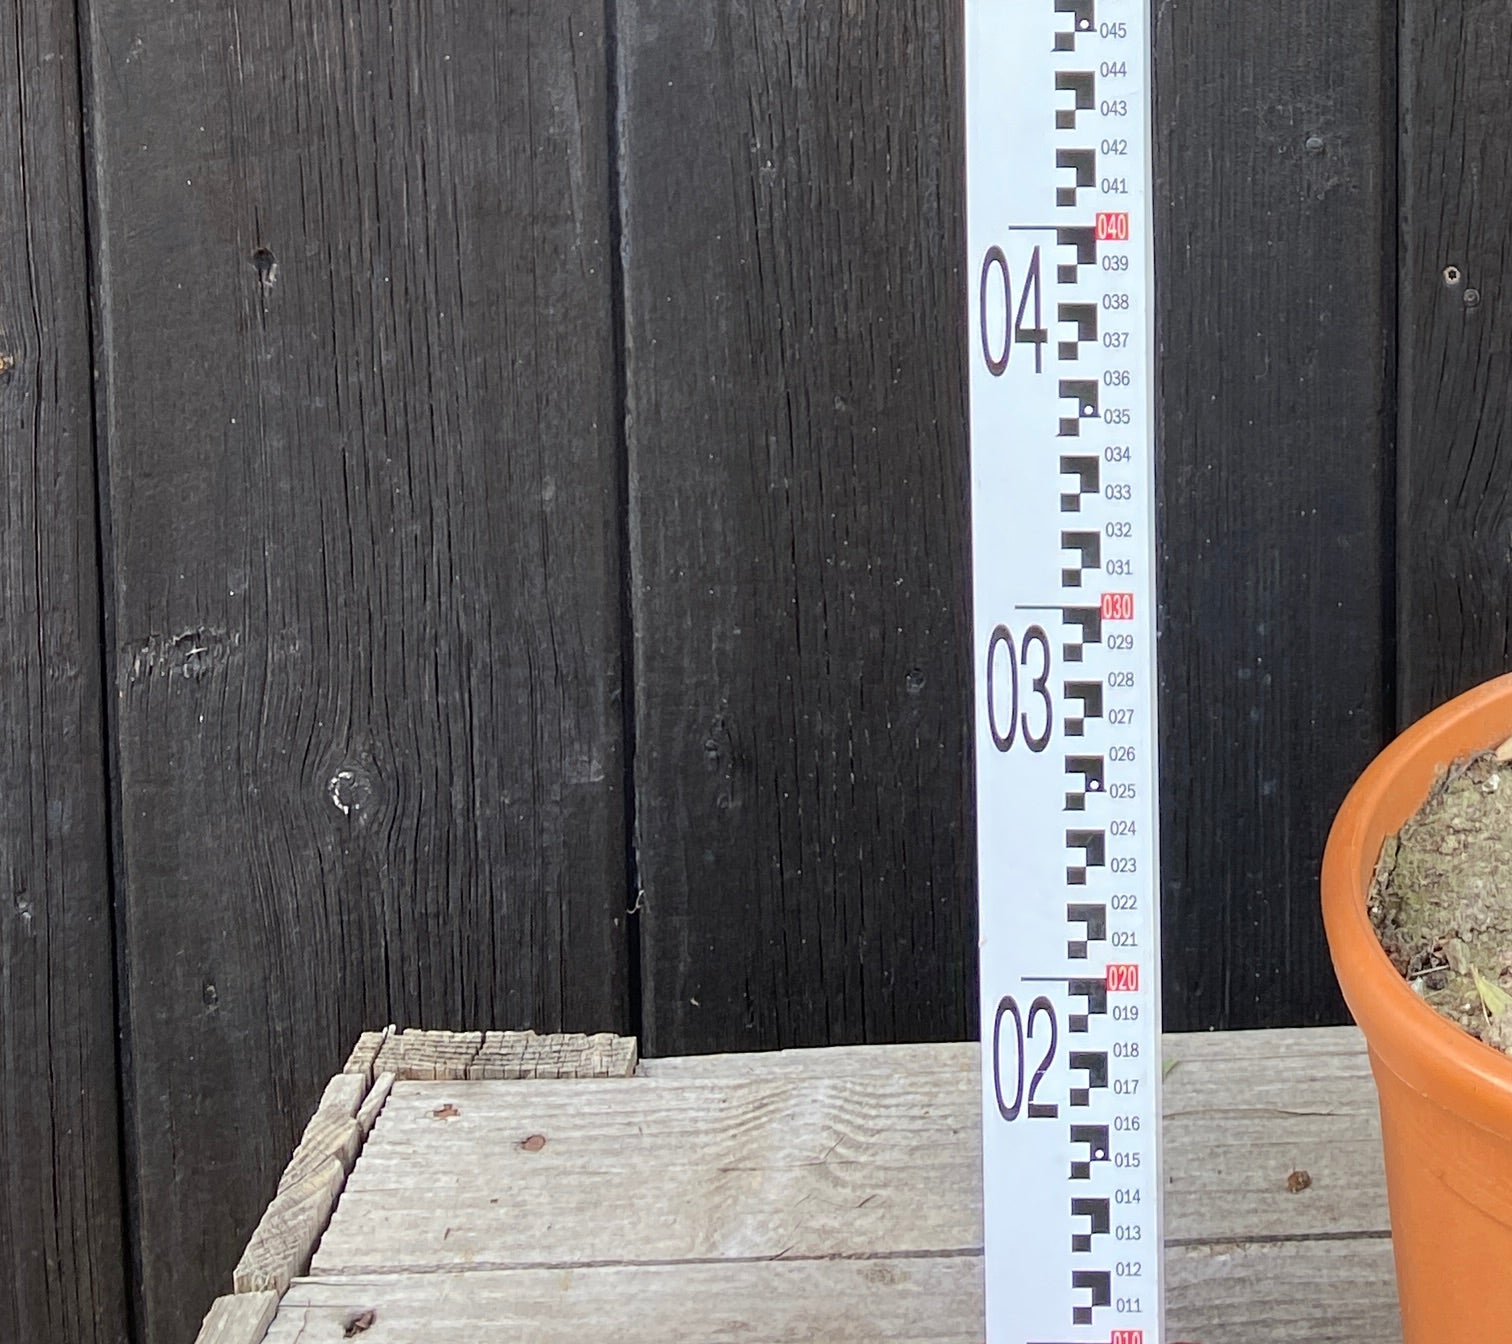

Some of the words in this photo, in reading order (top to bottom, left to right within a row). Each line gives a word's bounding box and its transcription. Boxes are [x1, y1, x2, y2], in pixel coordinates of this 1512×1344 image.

[1099, 22, 1127, 40] 045
[1099, 60, 1128, 78] 044
[1100, 99, 1128, 117] 043
[1100, 138, 1128, 156] 042
[1100, 177, 1129, 195] 041
[1097, 215, 1128, 239] 040
[1101, 254, 1129, 272] 039
[1102, 293, 1130, 310] 038
[980, 245, 1048, 376] 04
[1102, 331, 1130, 349] 037
[1103, 369, 1131, 387] 036
[1103, 408, 1131, 425] 035
[1104, 445, 1132, 463] 034
[1104, 483, 1132, 501] 033
[1105, 521, 1133, 538] 032
[1105, 559, 1134, 576] 031
[1102, 595, 1132, 619] 030
[1106, 633, 1134, 651] 029
[987, 624, 1052, 752] 03
[1107, 671, 1135, 688] 028
[1108, 708, 1135, 725] 027
[1108, 745, 1136, 762] 026
[1109, 783, 1137, 799] 025
[1109, 820, 1137, 837] 024
[1110, 857, 1137, 874] 023
[1110, 894, 1138, 911] 022
[1111, 931, 1139, 948] 021
[1108, 967, 1137, 991] 020
[1112, 1005, 1139, 1022] 019
[1112, 1041, 1140, 1058] 018
[993, 995, 1058, 1122] 02
[1113, 1079, 1140, 1095] 017
[1113, 1115, 1141, 1132] 016
[1114, 1151, 1141, 1169] 015
[1114, 1188, 1141, 1205] 014
[1115, 1224, 1142, 1241] 013
[1115, 1261, 1142, 1277] 012
[1116, 1297, 1142, 1314] 011
